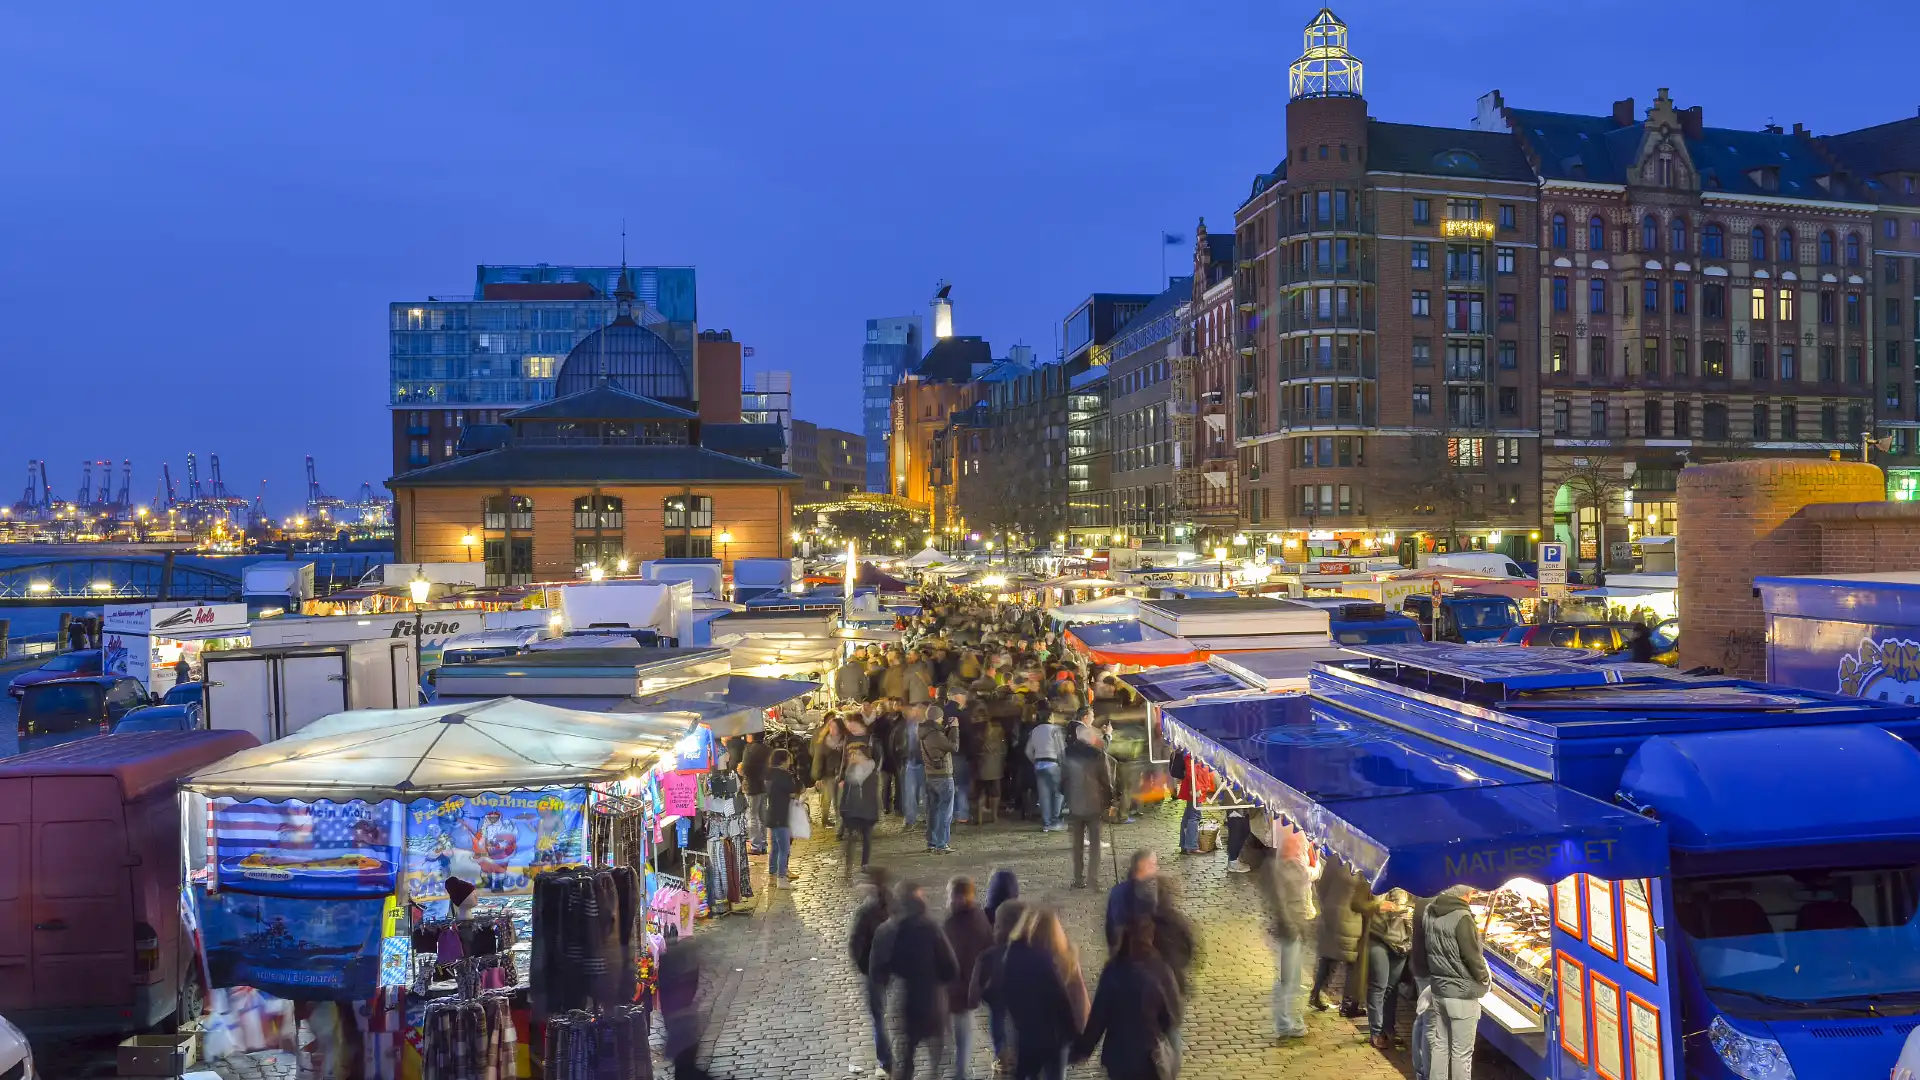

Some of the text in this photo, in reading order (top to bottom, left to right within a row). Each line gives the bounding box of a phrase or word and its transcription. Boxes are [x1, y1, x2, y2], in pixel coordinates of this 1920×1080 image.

[895, 396, 904, 431] stilwerk
[1547, 547, 1557, 560] P
[391, 620, 460, 638] fische
[1445, 839, 1618, 877] MATJESFILET
